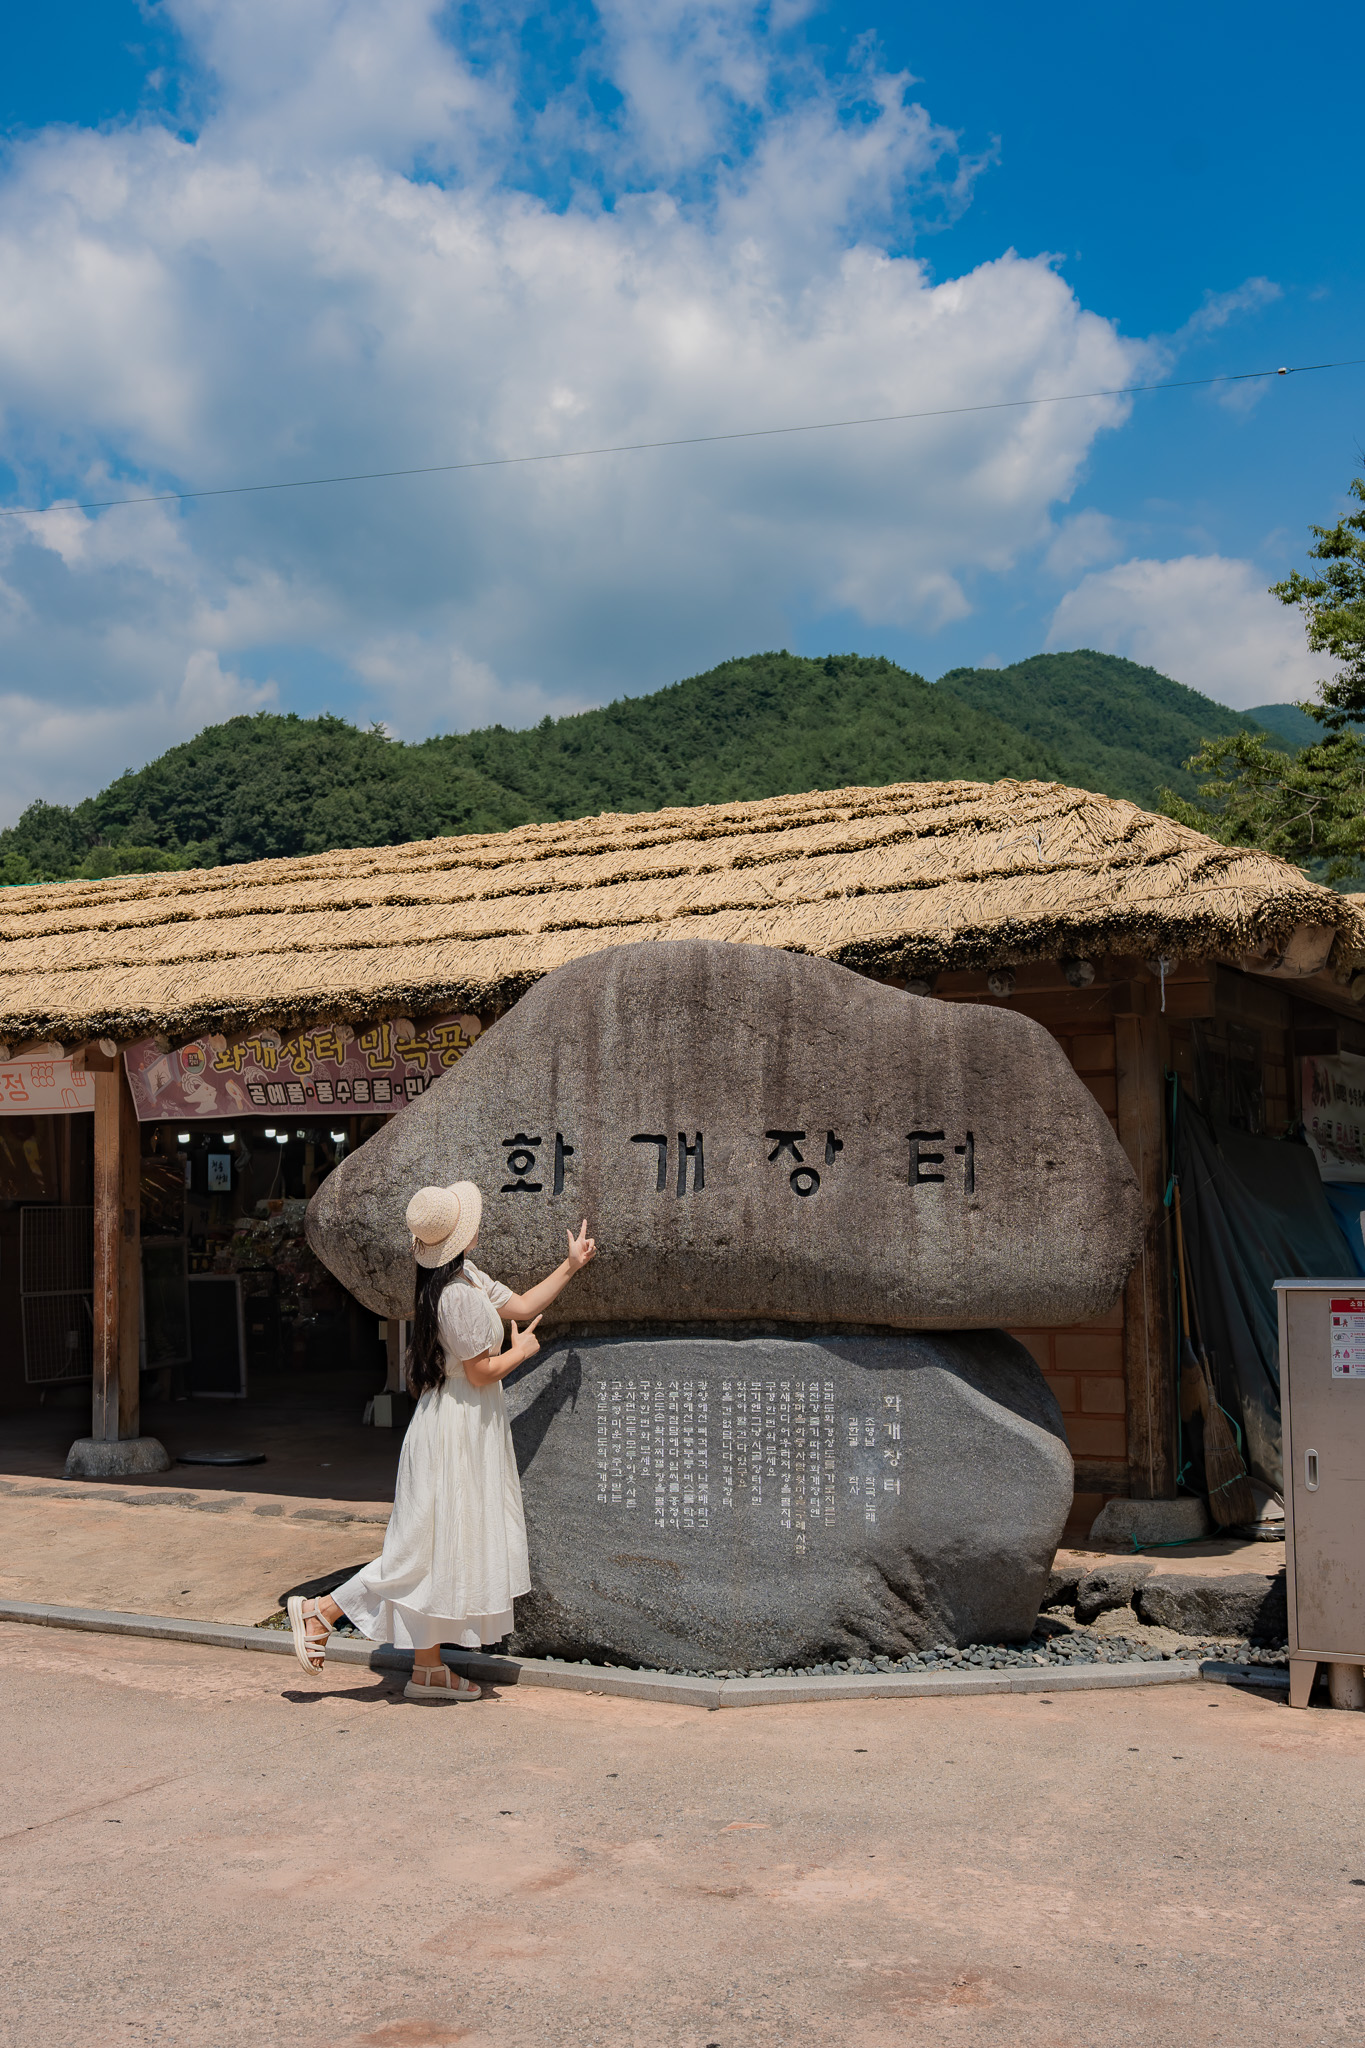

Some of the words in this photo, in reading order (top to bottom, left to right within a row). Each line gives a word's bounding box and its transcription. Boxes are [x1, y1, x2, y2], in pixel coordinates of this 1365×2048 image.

[360, 1023, 488, 1068] 민속공
[0, 1072, 30, 1101] 정
[501, 1130, 976, 1199] 화개장터
[597, 1381, 607, 1411] 경상도
[611, 1381, 622, 1400] 고운
[626, 1381, 637, 1411] 오시면
[640, 1381, 650, 1400] 구경
[668, 1381, 679, 1411] 사투리
[722, 1381, 732, 1401] 없을
[736, 1381, 747, 1412] 있어야
[750, 1381, 762, 1412] 보기엔
[765, 1381, 777, 1401] 구경
[810, 1381, 820, 1412] 섬진강
[611, 1405, 622, 1414] 정
[640, 1404, 650, 1413] 한
[655, 1381, 665, 1422] 오손도손
[698, 1381, 708, 1422] 광양에선
[722, 1406, 732, 1415] 건
[765, 1405, 777, 1414] 한
[780, 1381, 791, 1423] 닷새마다
[794, 1381, 806, 1423] 아랫마을
[824, 1381, 835, 1423] 전라도와
[611, 1419, 622, 1438] 미운
[626, 1415, 637, 1435] 모두
[640, 1418, 650, 1427] 번
[736, 1416, 747, 1425] 할
[750, 1416, 762, 1436] 그냥
[765, 1418, 777, 1427] 번
[810, 1416, 820, 1436] 줄기
[597, 1415, 607, 1457] 전라도의
[640, 1431, 650, 1440] 와
[668, 1415, 679, 1457] 잡담에다
[722, 1419, 732, 1461] 없답니다
[736, 1430, 747, 1438] 건
[765, 1432, 777, 1441] 와
[848, 1417, 860, 1447] 김한길
[865, 1417, 876, 1447] 조영남
[611, 1443, 622, 1452] 정
[626, 1440, 637, 1460] 모두
[683, 1427, 694, 1468] 부릉부릉
[736, 1443, 747, 1452] 다
[750, 1440, 762, 1460] 시골
[780, 1427, 791, 1469] 어우러져
[810, 1440, 820, 1460] 따라
[824, 1428, 835, 1469] 경상도를
[883, 1395, 902, 1495] 화개장터
[611, 1457, 623, 1476] 주고
[640, 1445, 650, 1475] 보세요
[765, 1445, 777, 1476] 보세요
[794, 1451, 806, 1471] 사람
[626, 1464, 638, 1484] 이웃
[736, 1456, 748, 1487] 있구요
[597, 1461, 608, 1503] 화개장터
[612, 1482, 623, 1502] 받는
[656, 1472, 666, 1492] 장을
[722, 1465, 733, 1507] 화개장터
[750, 1464, 763, 1505] 장터지만
[781, 1473, 792, 1493] 장을
[810, 1464, 821, 1517] 화개장터엔
[848, 1476, 860, 1495] 작사
[627, 1488, 638, 1508] 사촌
[825, 1473, 836, 1526] 가로지르는
[684, 1507, 695, 1527] 타고
[699, 1507, 709, 1527] 타고
[795, 1534, 807, 1554] 사람
